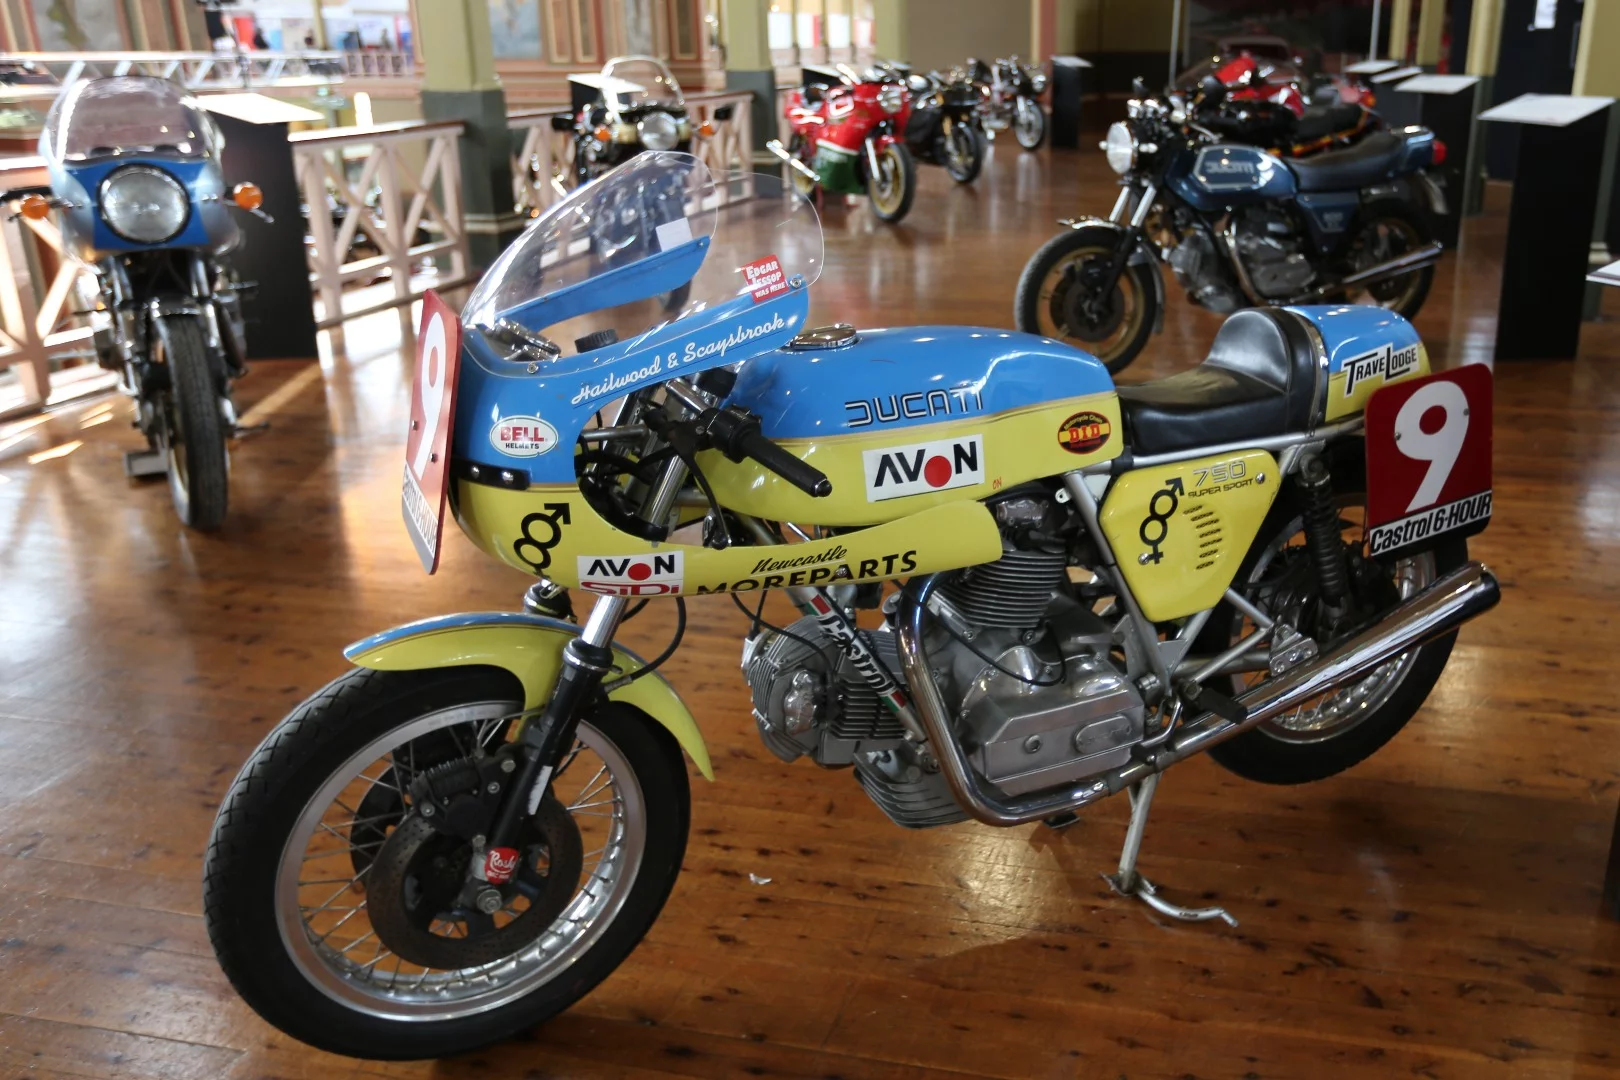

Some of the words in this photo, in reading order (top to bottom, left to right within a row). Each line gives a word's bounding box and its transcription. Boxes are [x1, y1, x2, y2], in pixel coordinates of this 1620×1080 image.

[745, 261, 778, 280] EDGAR
[755, 288, 770, 298] WAS
[571, 356, 662, 404] Hailwood
[667, 352, 680, 369] &
[683, 312, 786, 363] Scaysbrook
[413, 311, 446, 480] 9
[845, 385, 983, 428] DUCATI
[500, 426, 546, 442] BELL
[505, 442, 540, 450] HELMETS
[1069, 423, 1101, 443] DID
[1394, 380, 1470, 514] 9
[873, 440, 979, 488] AVON
[1193, 460, 1246, 487] 750
[1188, 485, 1222, 498] SUPER
[1223, 478, 1254, 492] SPORT
[1370, 512, 1435, 554] Castrol
[1434, 493, 1493, 532] 6-HOUR
[587, 555, 675, 581] AVON
[696, 550, 917, 595] MOREPARTS
[751, 545, 847, 574] Newcastle
